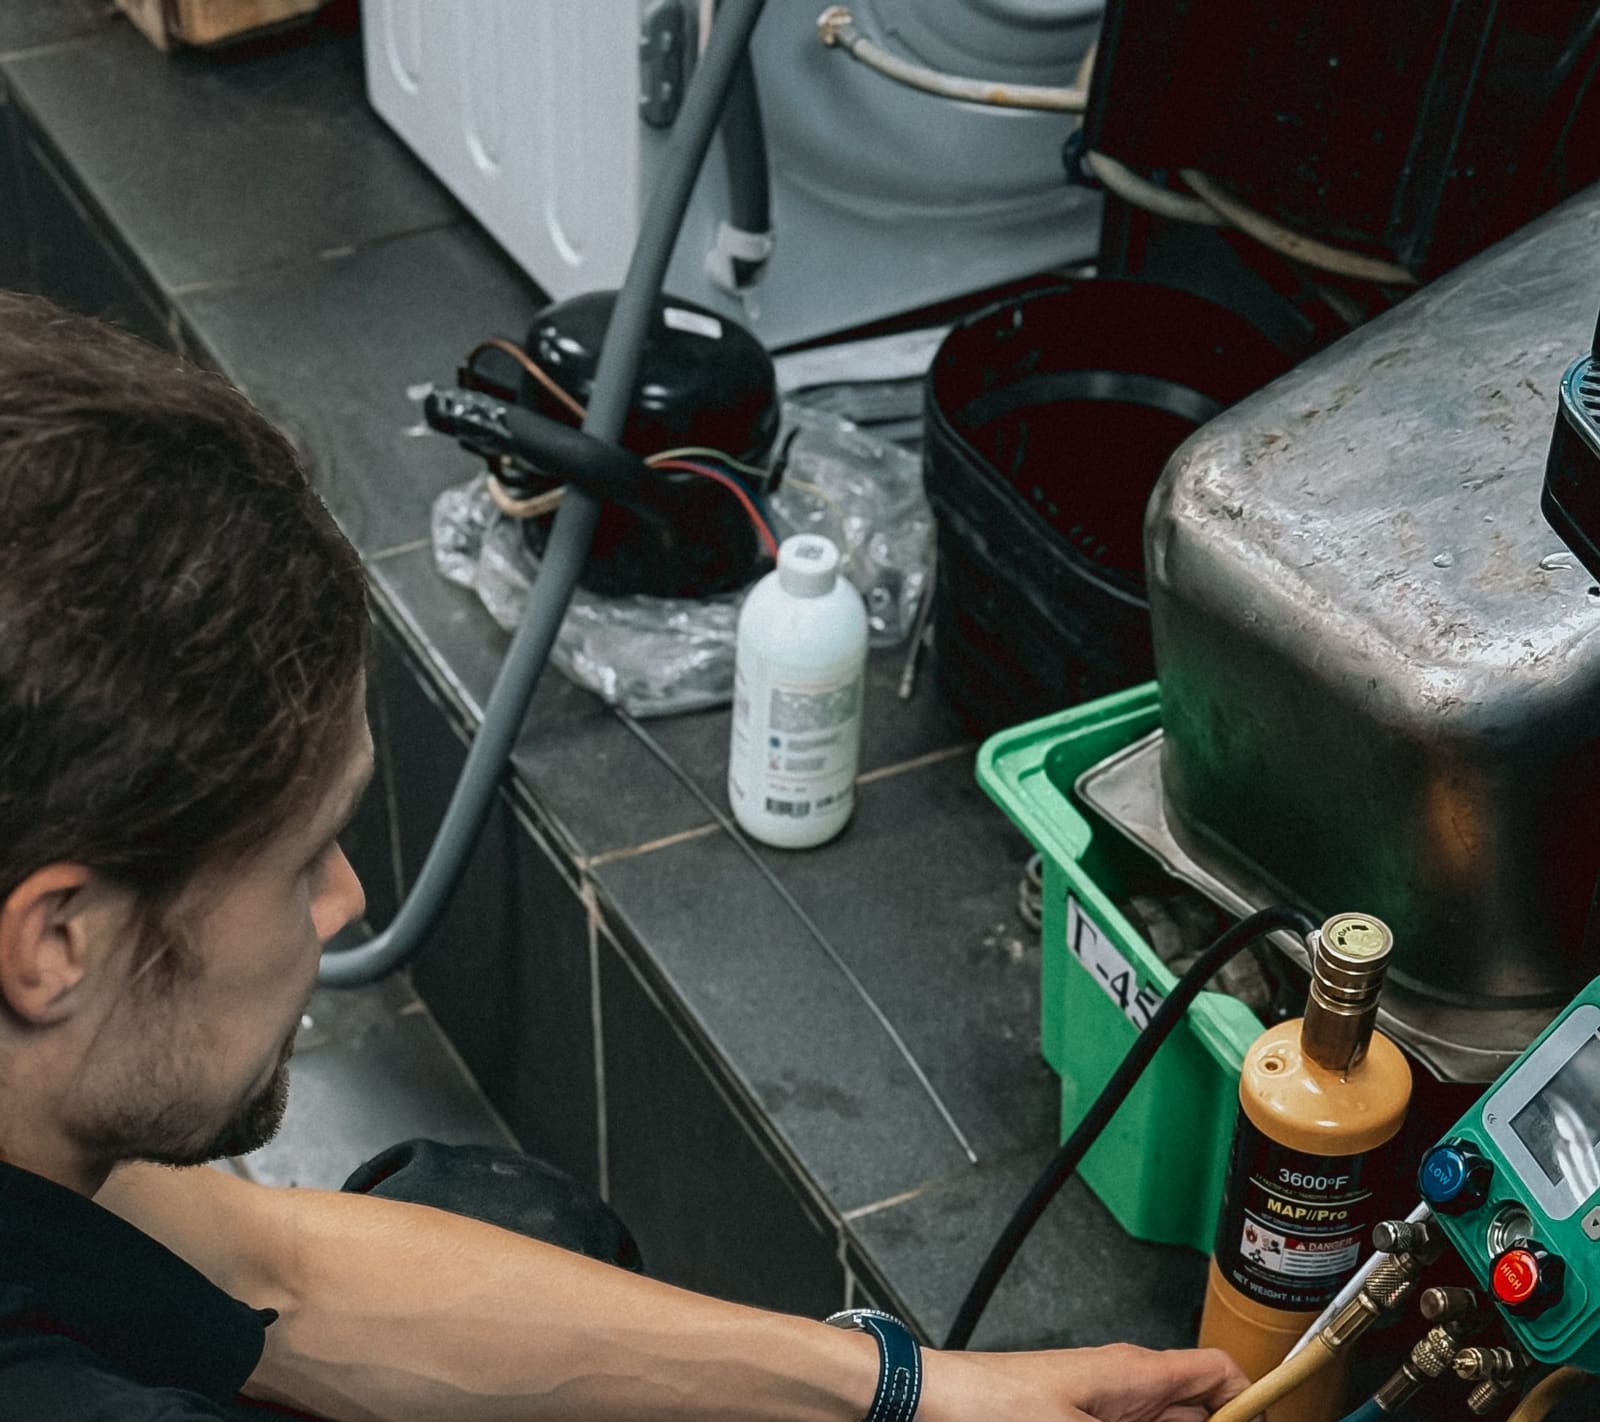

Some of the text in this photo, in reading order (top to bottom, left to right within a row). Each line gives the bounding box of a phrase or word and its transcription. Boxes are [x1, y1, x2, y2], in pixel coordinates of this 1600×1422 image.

[1278, 1167, 1349, 1191] 3600°F
[1428, 1162, 1451, 1185] LOW
[1267, 1198, 1348, 1222] MAP//Pro
[1308, 1237, 1353, 1251] DANGER
[1500, 1262, 1523, 1290] HIGH
[1249, 1281, 1288, 1301] WEIGHT
